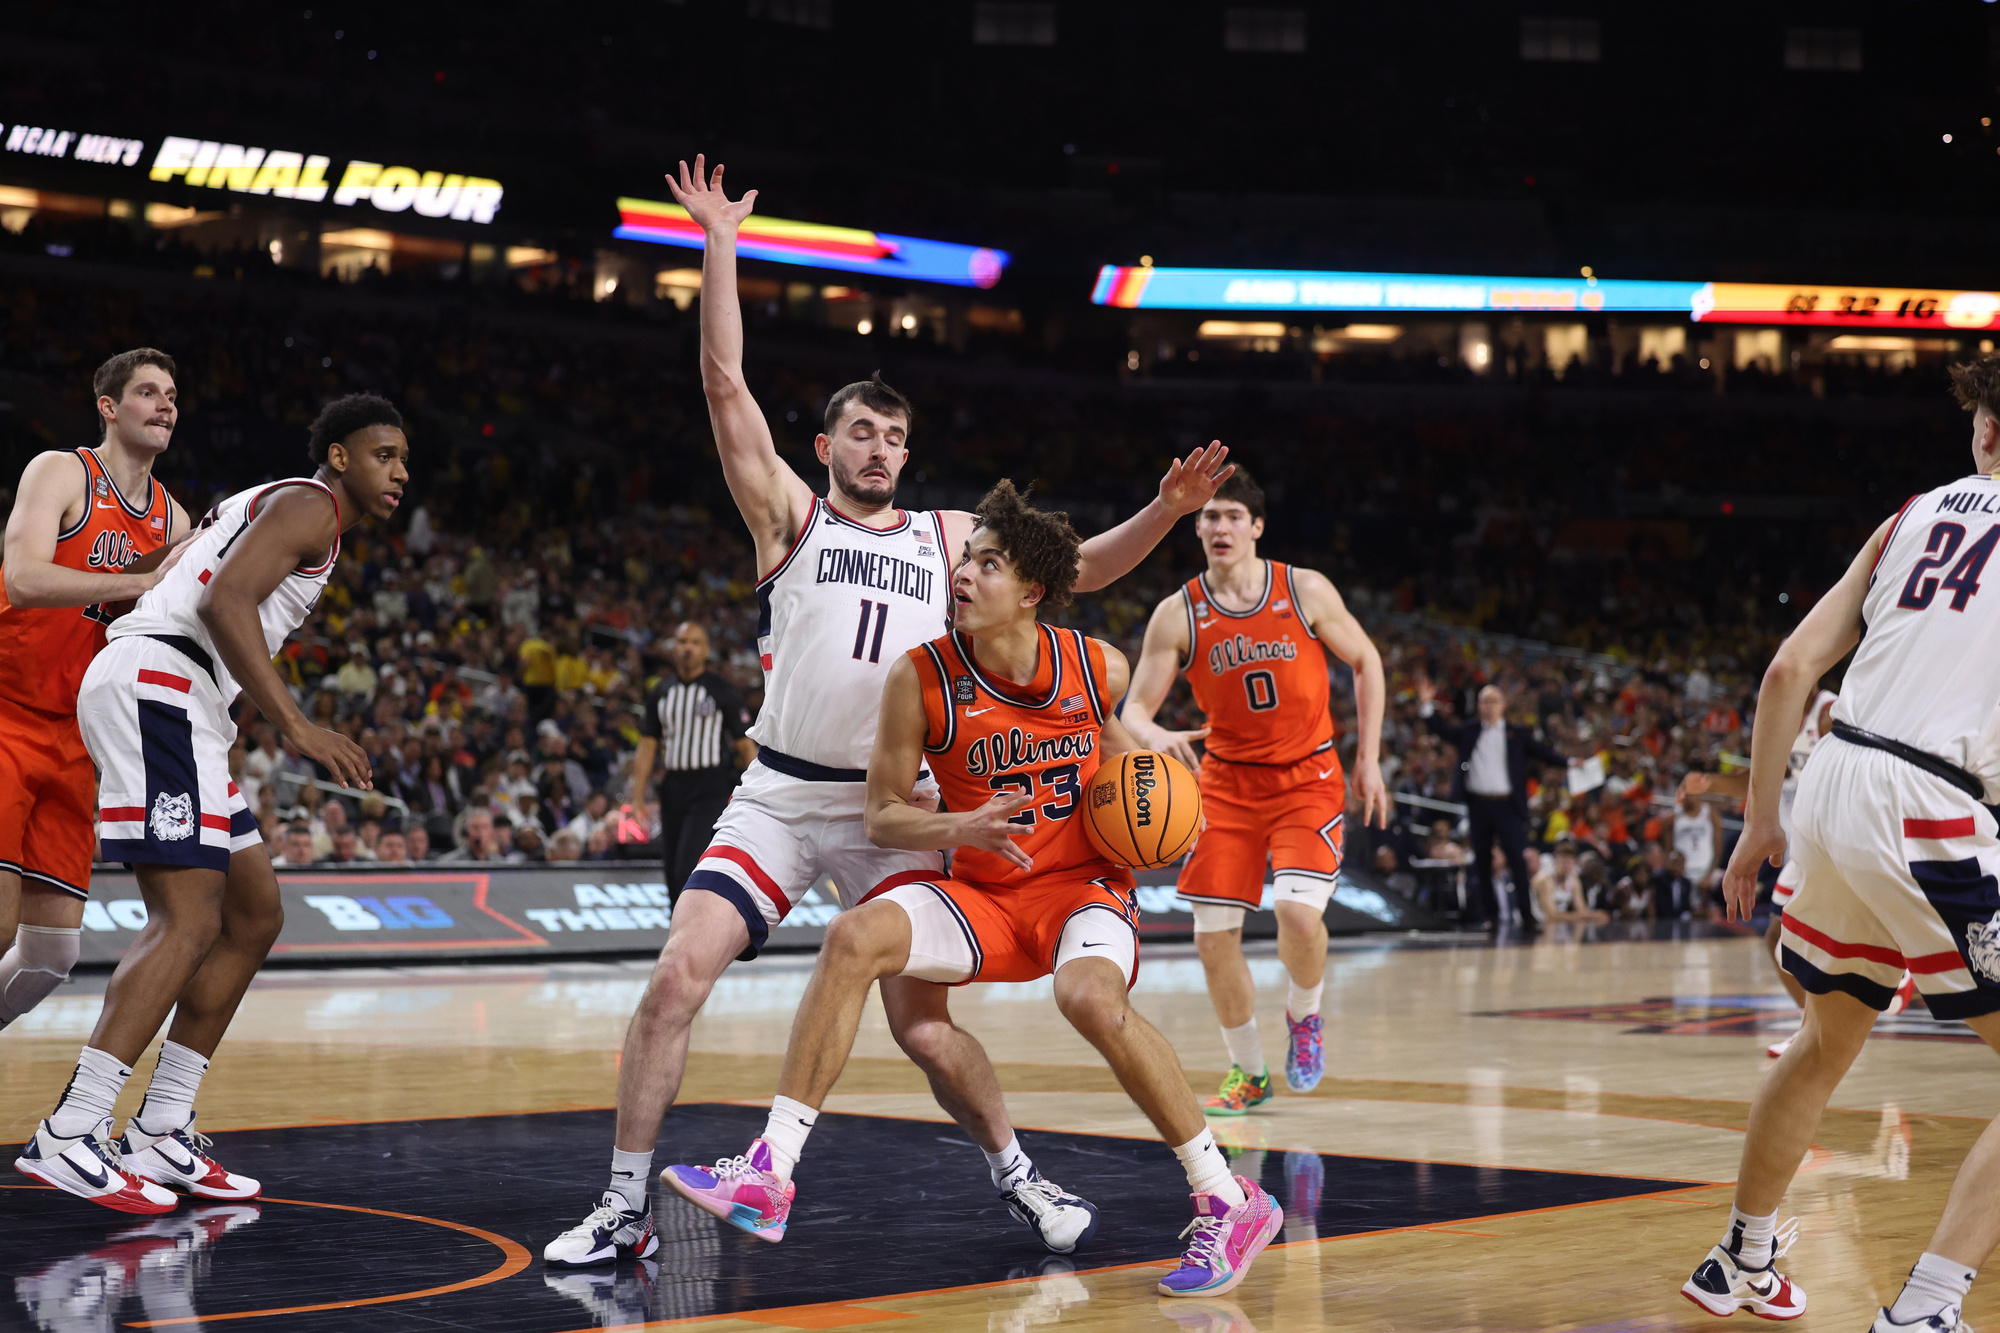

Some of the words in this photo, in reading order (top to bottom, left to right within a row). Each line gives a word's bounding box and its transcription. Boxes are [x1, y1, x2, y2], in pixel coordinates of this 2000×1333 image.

[149, 135, 331, 202] FINAL
[333, 160, 504, 225] FOUR
[816, 548, 934, 605] CONNECTICUT
[1897, 521, 2000, 612] 24
[852, 598, 889, 664] 11
[1209, 633, 1298, 675] Illinois
[956, 680, 973, 688] FINAL
[1242, 669, 1279, 713] 0
[966, 727, 1095, 776] Illinois
[988, 763, 1082, 822] 23
[1133, 754, 1158, 829] Wilson
[524, 908, 671, 931] THER
